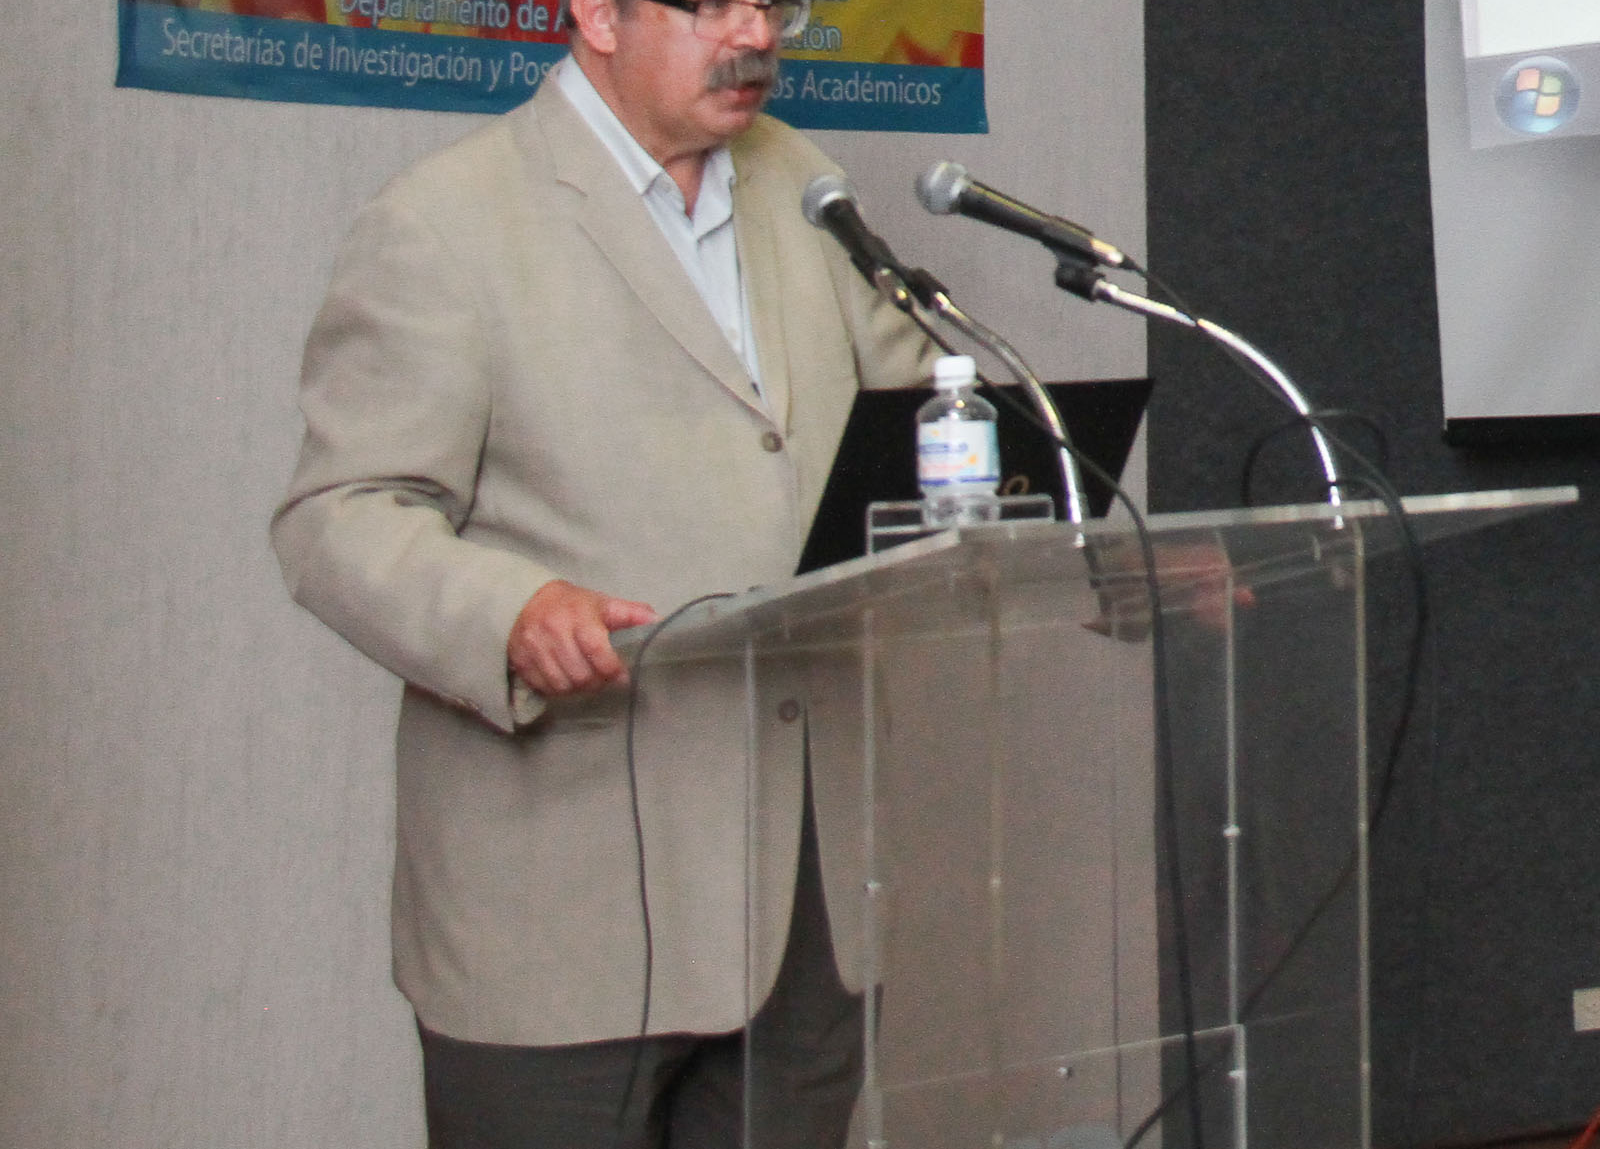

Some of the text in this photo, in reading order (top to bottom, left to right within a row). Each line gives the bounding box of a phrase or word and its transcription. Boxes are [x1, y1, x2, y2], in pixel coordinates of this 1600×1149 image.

[161, 17, 285, 69] Secretarías
[293, 38, 322, 70] de
[329, 36, 482, 88] Investigación
[489, 59, 503, 92] y
[509, 51, 553, 86] Pos
[802, 68, 942, 105] Académicos
